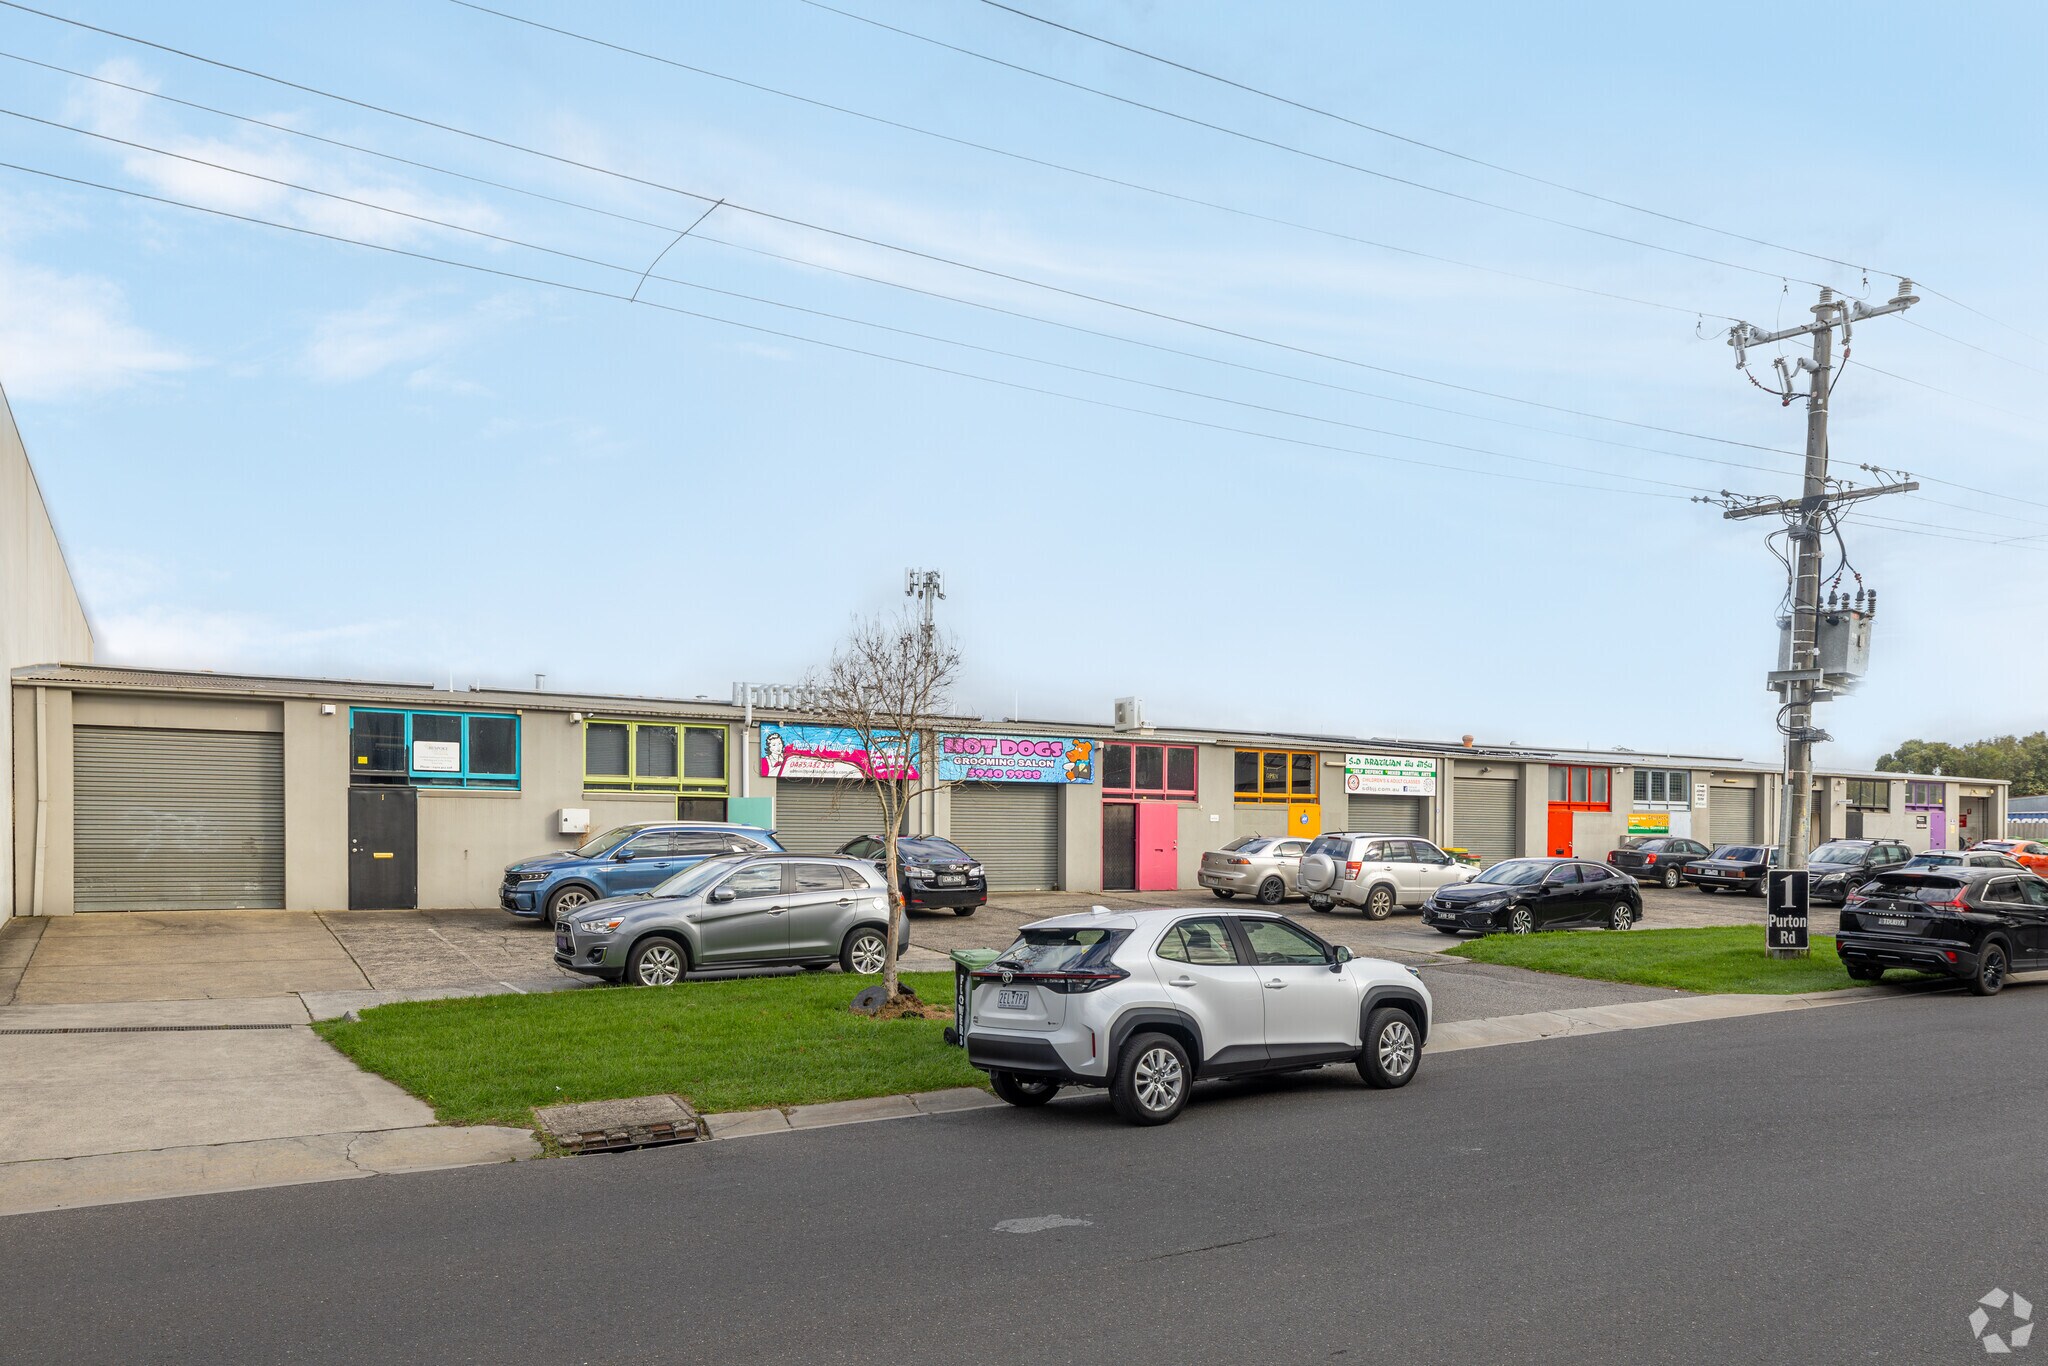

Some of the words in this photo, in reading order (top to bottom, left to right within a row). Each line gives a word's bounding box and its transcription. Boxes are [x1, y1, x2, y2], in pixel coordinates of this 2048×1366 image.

[943, 737, 997, 754] HOT
[1000, 740, 1063, 757] DOGS
[954, 757, 1015, 766] GROOMING
[1018, 758, 1054, 768] SALON
[967, 768, 1003, 778] 5940
[1006, 769, 1041, 779] 9988
[1780, 874, 1796, 908] 1
[1769, 914, 1807, 928] Purton
[1780, 931, 1796, 944] Rd
